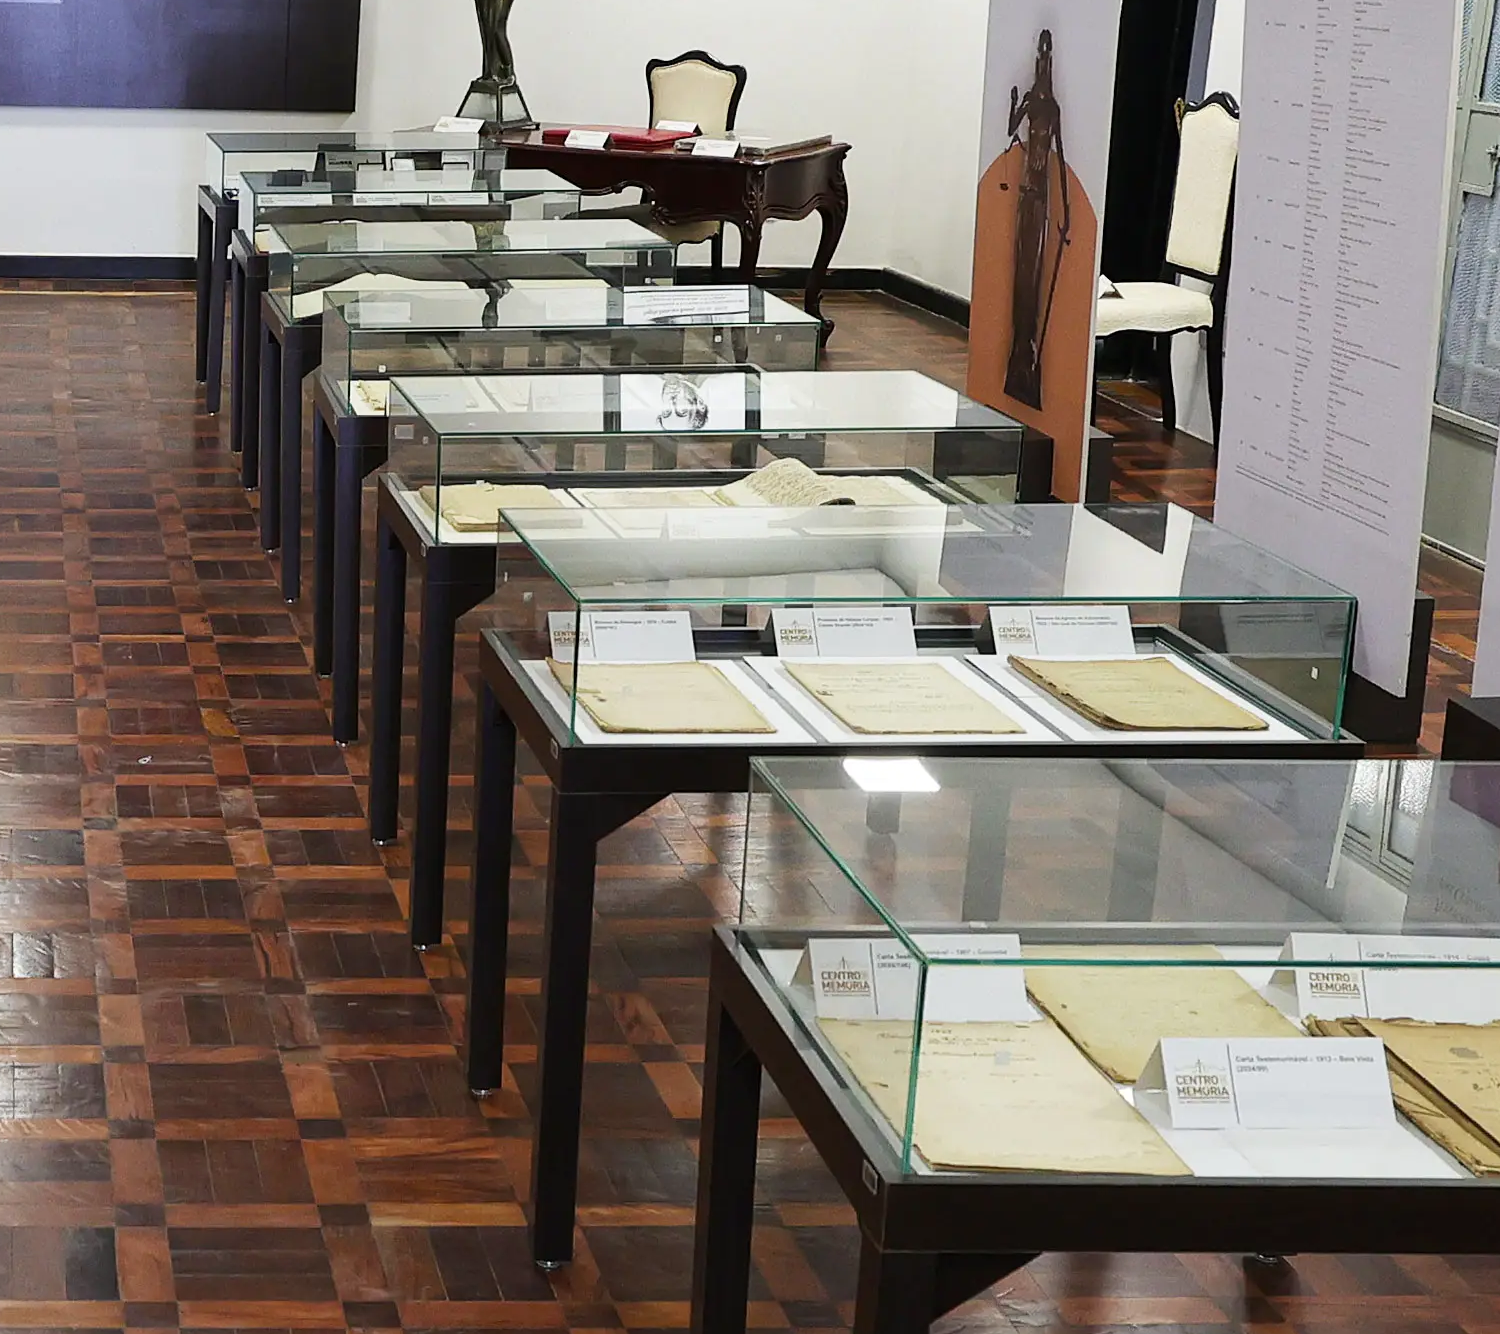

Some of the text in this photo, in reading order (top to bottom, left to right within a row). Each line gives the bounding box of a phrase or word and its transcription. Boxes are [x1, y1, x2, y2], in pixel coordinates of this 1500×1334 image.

[821, 971, 861, 980] CENTRO
[1309, 972, 1350, 982] CENTRO
[1175, 1075, 1219, 1085] CENTRO
